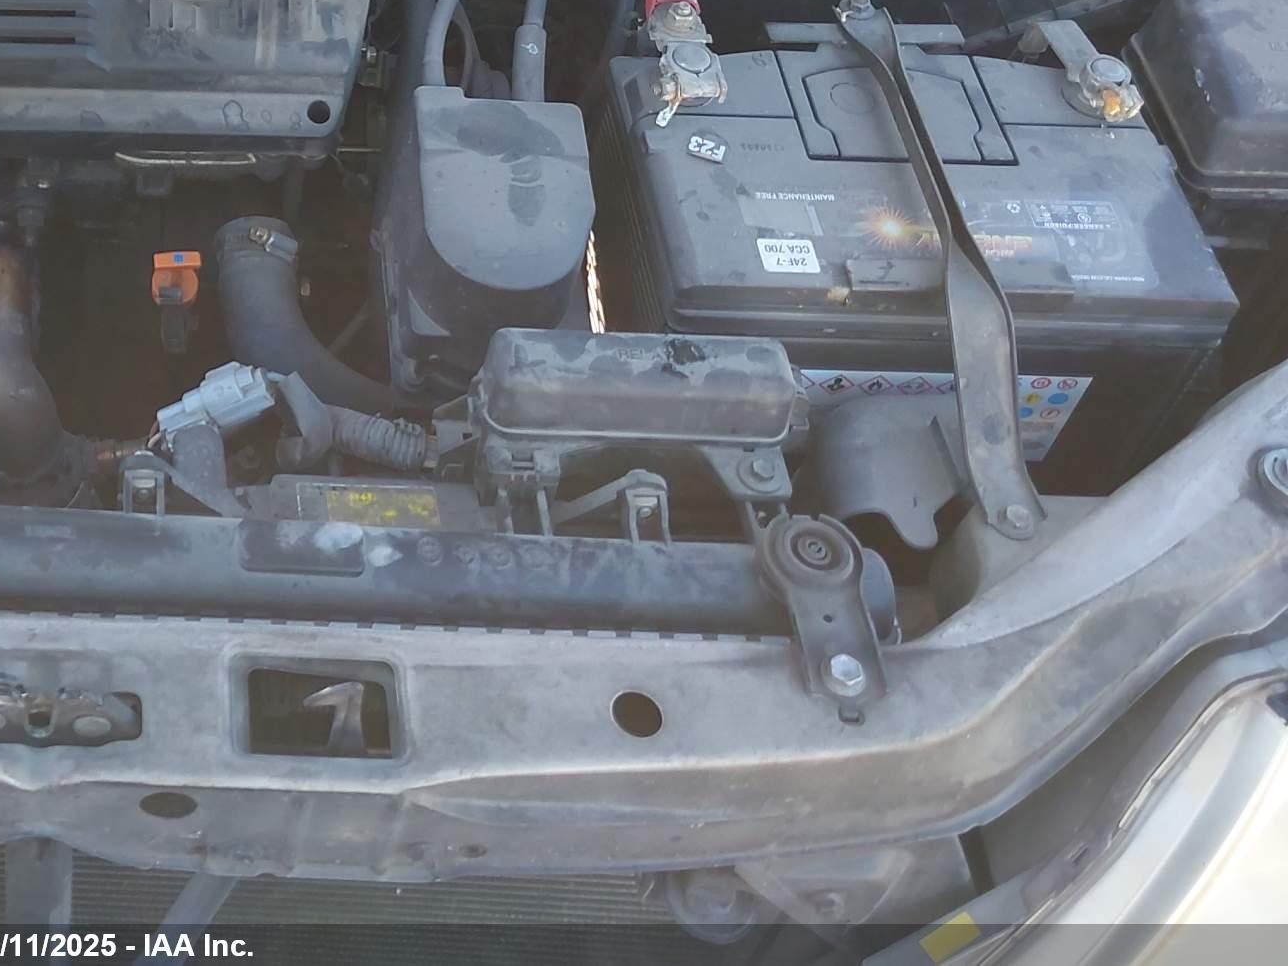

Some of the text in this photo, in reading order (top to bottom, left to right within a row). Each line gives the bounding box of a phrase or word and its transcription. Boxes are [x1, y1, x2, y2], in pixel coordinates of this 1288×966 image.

[688, 135, 726, 161] F23
[755, 191, 835, 202] MAINTENANCE FREE
[764, 244, 811, 255] CCA 700
